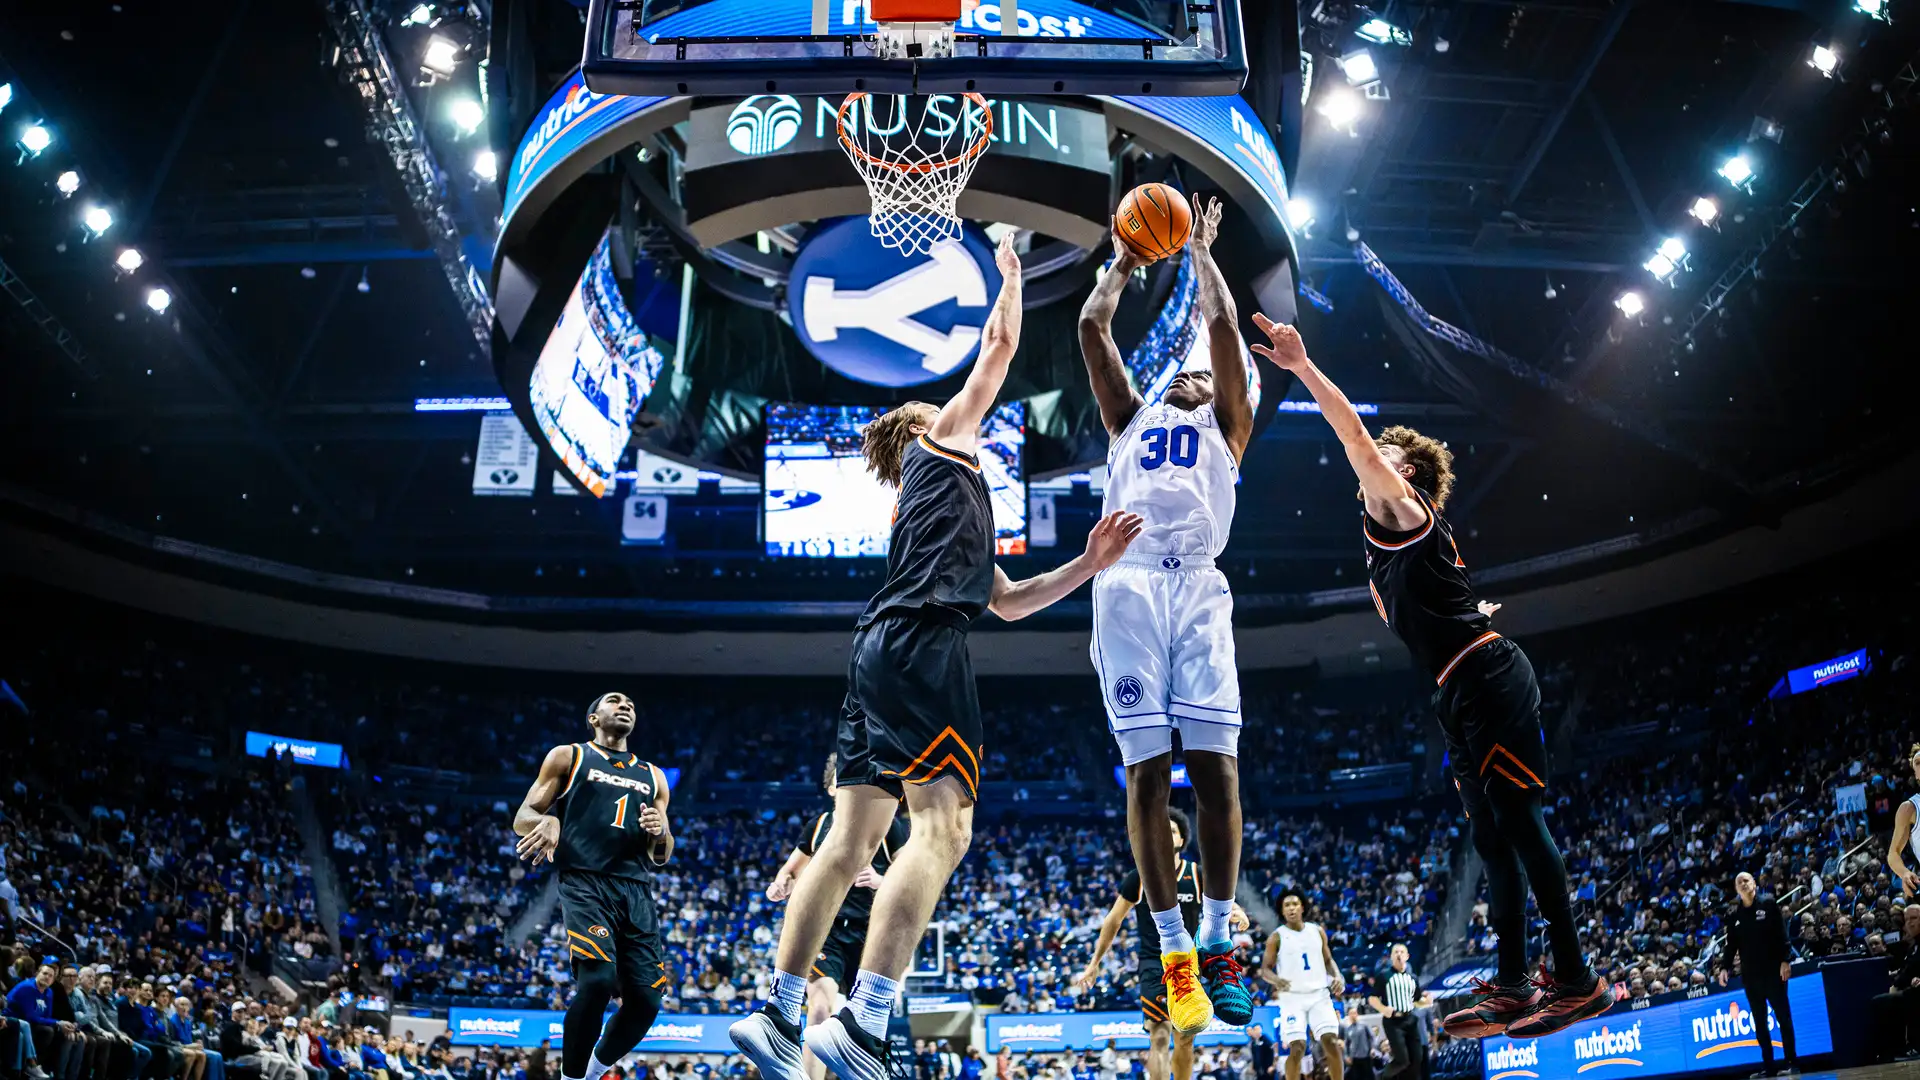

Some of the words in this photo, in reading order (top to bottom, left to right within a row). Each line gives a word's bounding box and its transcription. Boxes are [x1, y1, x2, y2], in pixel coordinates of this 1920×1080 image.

[842, 0, 1093, 37] nicost
[519, 84, 604, 175] nutric
[816, 94, 906, 138] NU
[1140, 425, 1199, 471] 30
[633, 501, 658, 519] 54
[1813, 655, 1860, 680] nutricost
[587, 768, 651, 795] PACIFIC
[610, 793, 629, 829] 1
[1302, 953, 1311, 970] 1
[460, 1018, 521, 1033] nutricost
[646, 1023, 703, 1037] utricost
[999, 1023, 1062, 1038] nutricost
[1487, 1041, 1539, 1071] nutricost
[1574, 1025, 1642, 1060] nutricost
